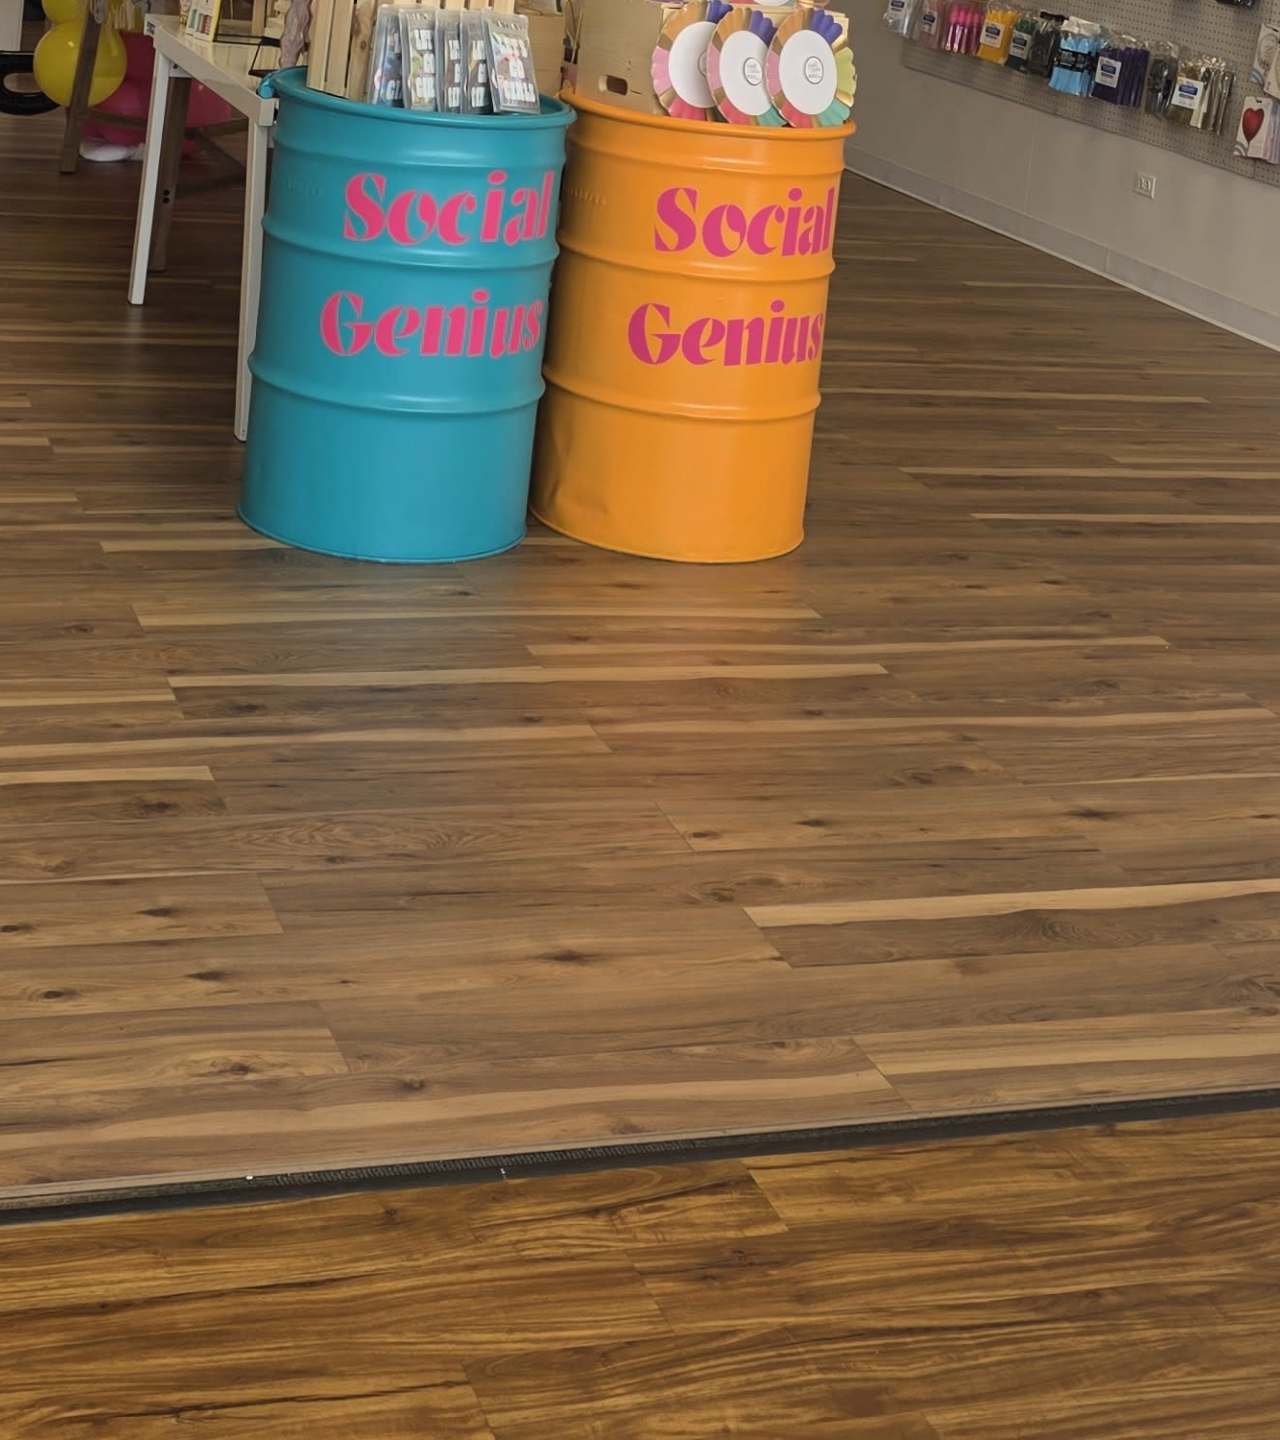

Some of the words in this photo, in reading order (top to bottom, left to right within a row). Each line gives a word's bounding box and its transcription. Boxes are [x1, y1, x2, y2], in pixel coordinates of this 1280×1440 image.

[343, 170, 554, 245] Social
[654, 186, 834, 259] Social
[321, 289, 544, 359] Genius
[628, 299, 824, 368] Genius
